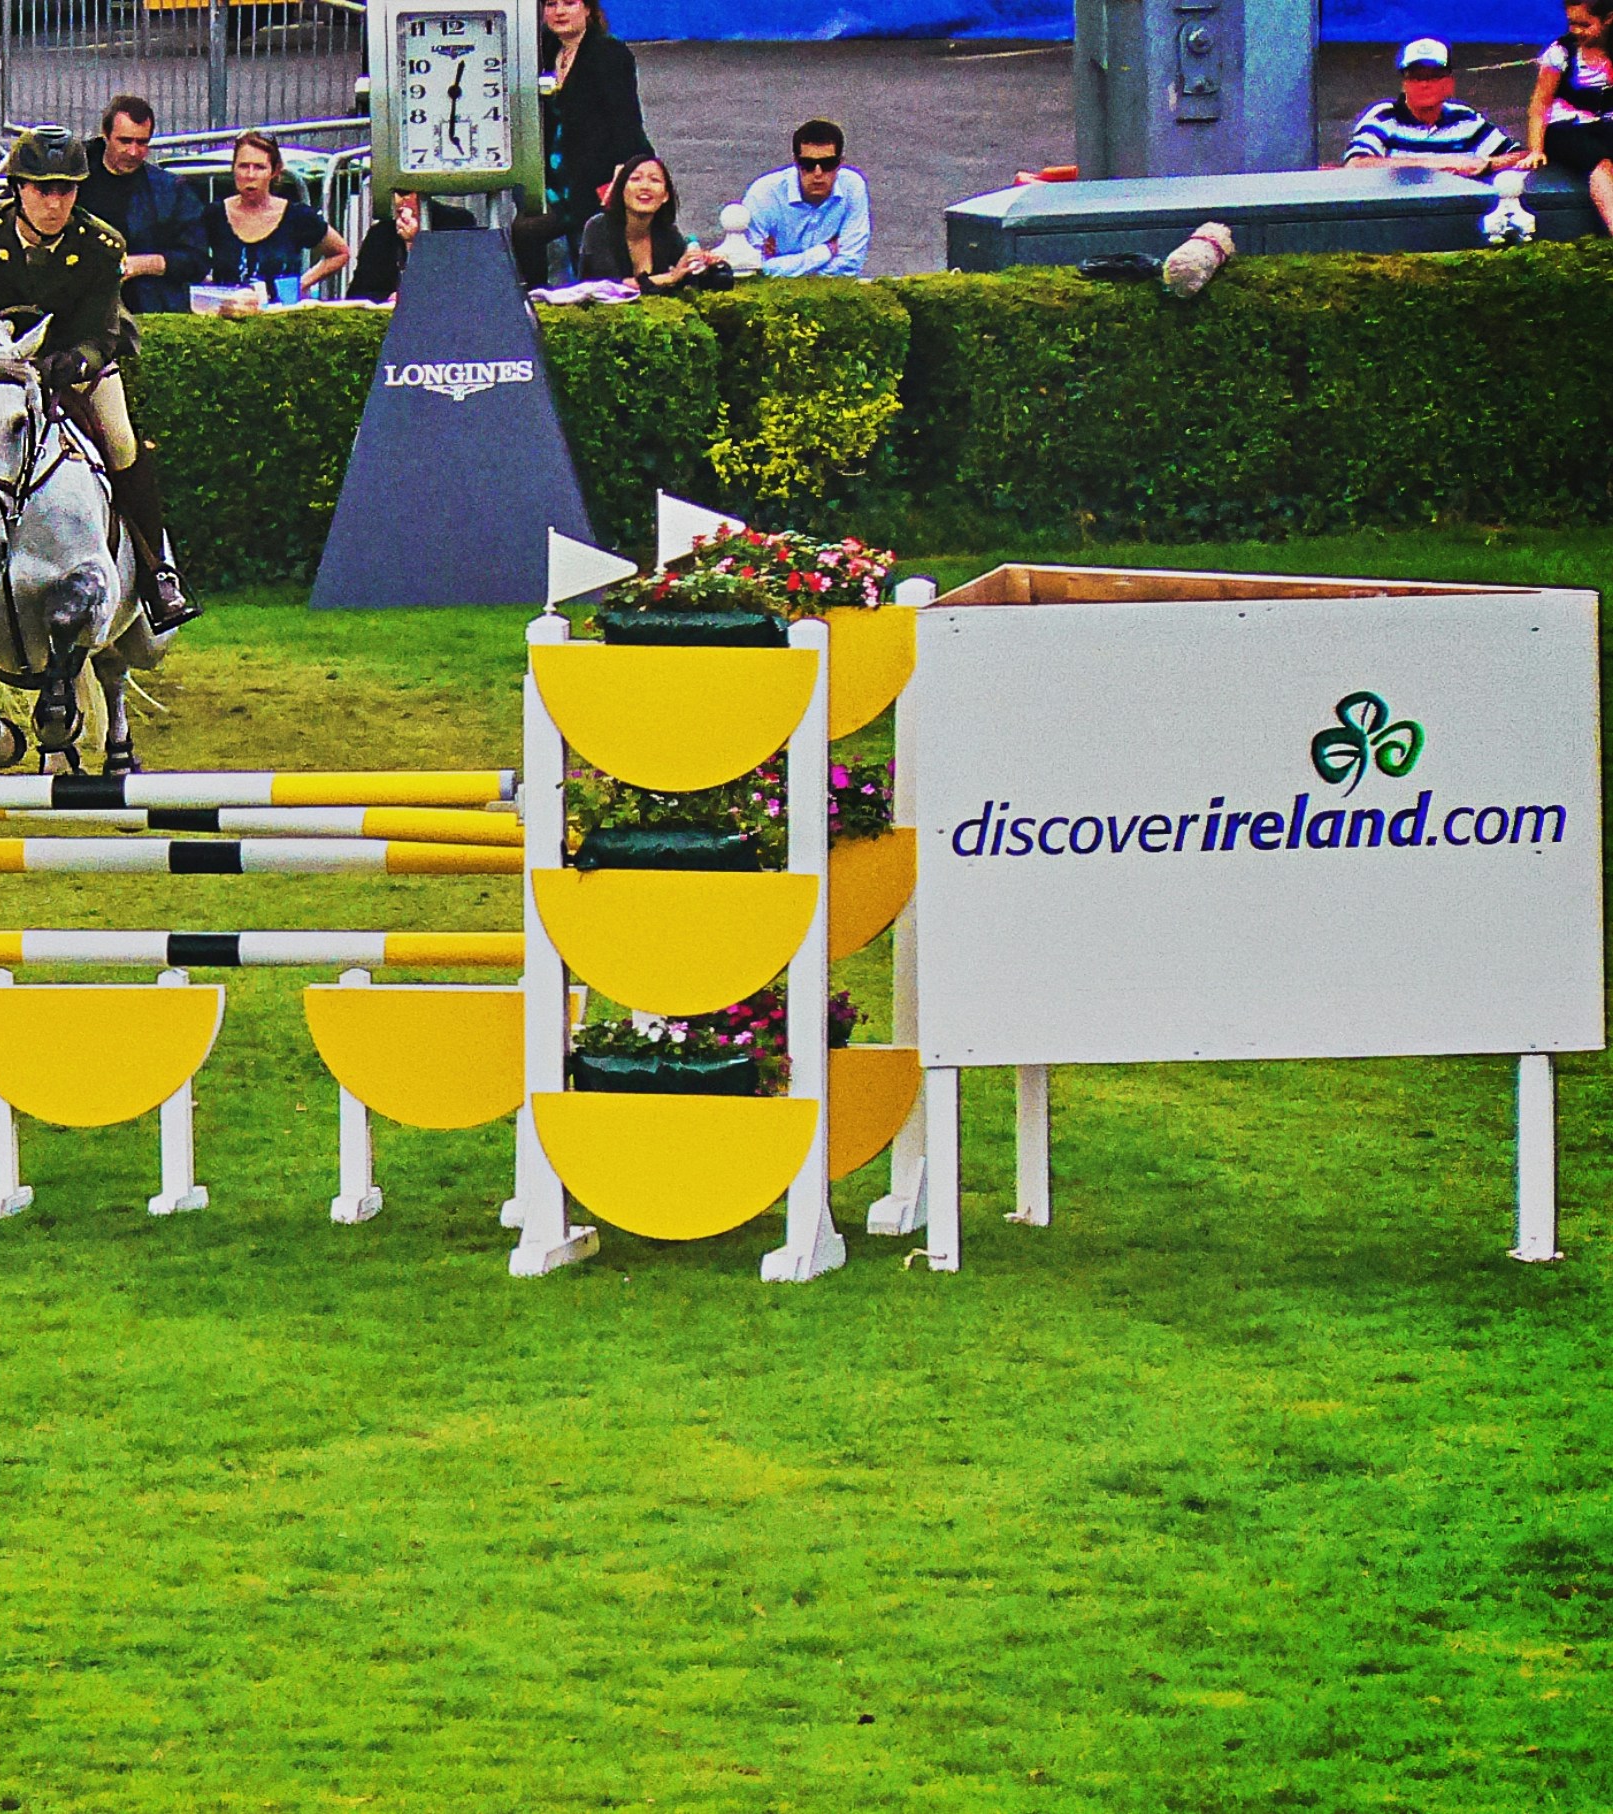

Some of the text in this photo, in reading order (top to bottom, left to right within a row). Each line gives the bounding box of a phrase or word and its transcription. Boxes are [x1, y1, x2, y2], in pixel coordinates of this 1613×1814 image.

[410, 21, 426, 36] 11
[441, 20, 465, 36] 12
[486, 19, 493, 35] 1
[409, 59, 431, 74] 10
[484, 58, 501, 72] 2
[410, 84, 426, 99] 9
[483, 82, 500, 98] 3
[410, 109, 427, 124] 8
[483, 106, 501, 121] 4
[411, 148, 428, 163] 7
[486, 147, 501, 161] 5
[384, 360, 534, 386] LONGINES
[952, 790, 1567, 857] discoverireland.com
